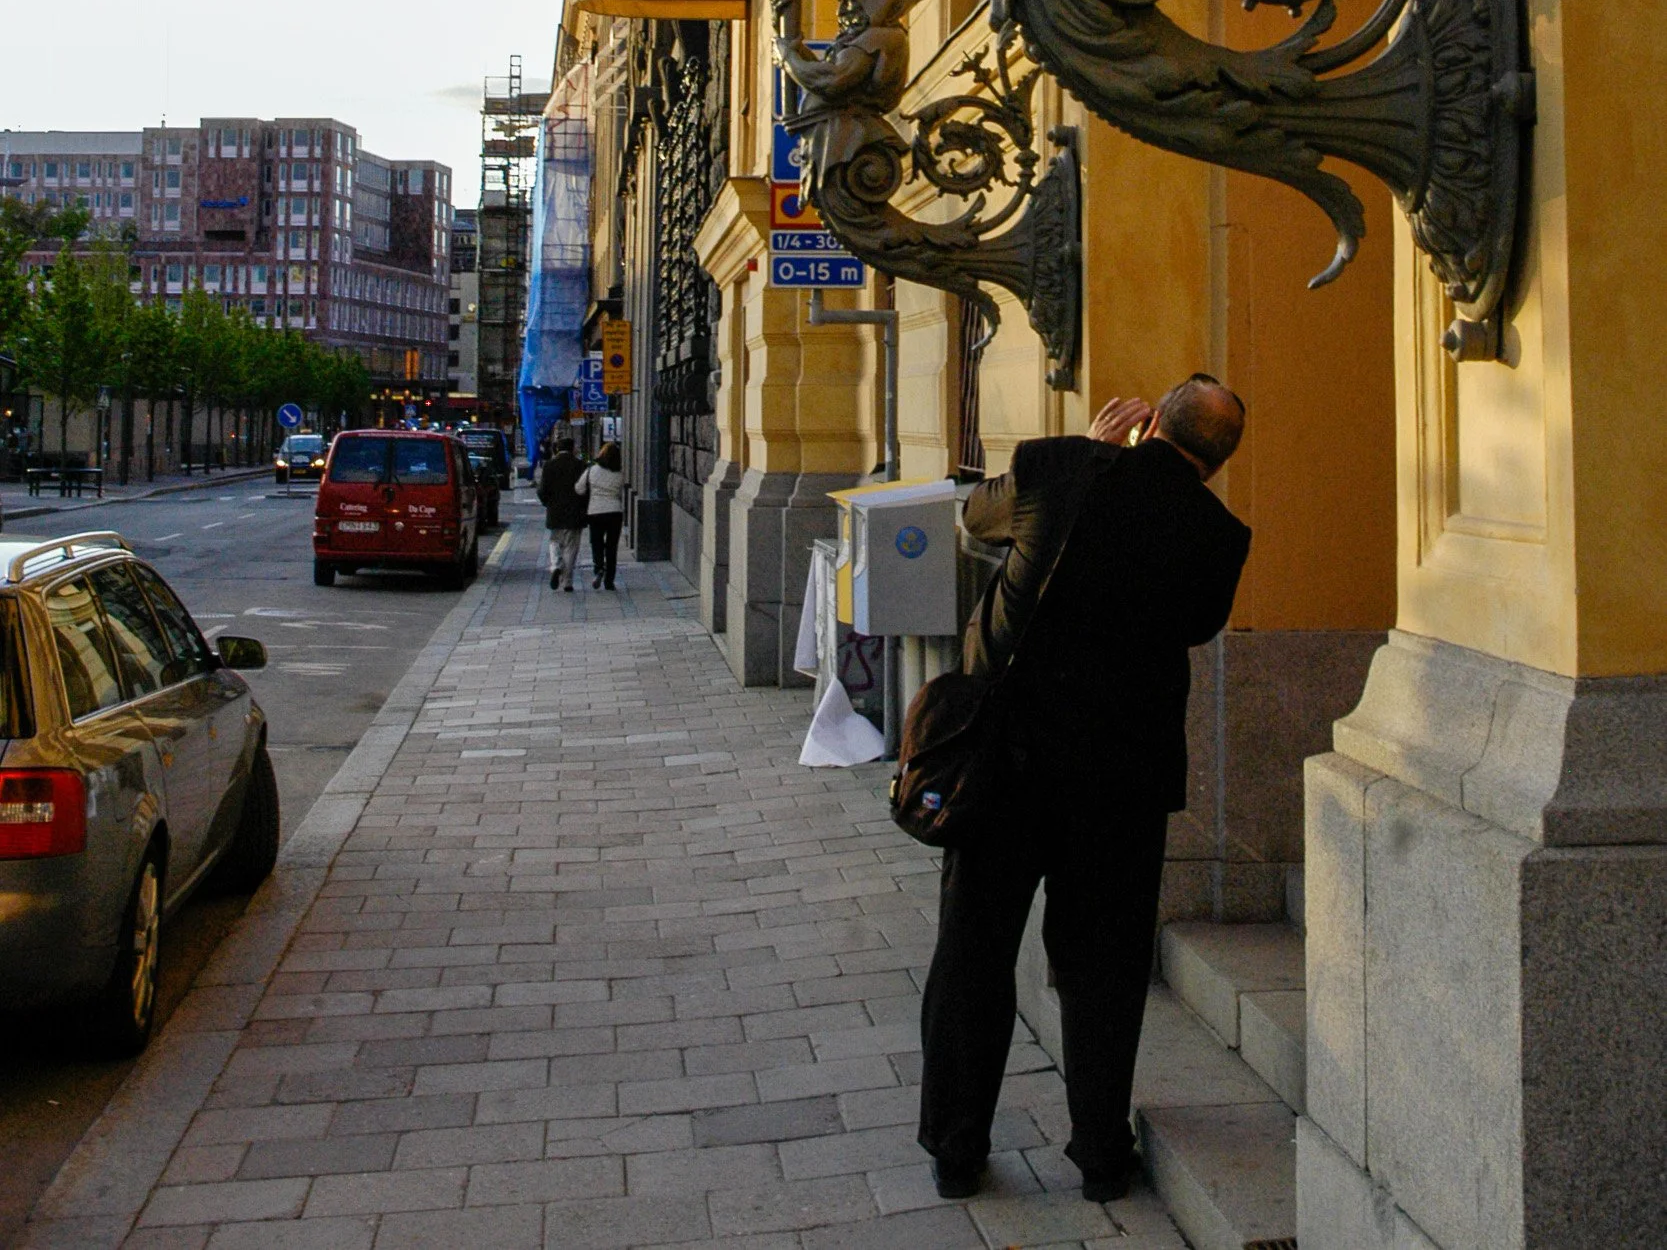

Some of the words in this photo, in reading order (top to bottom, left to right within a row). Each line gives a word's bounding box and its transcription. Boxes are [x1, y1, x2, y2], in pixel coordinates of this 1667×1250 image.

[777, 234, 801, 250] 1/4
[778, 262, 830, 281] 0-15
[840, 266, 859, 281] m
[590, 361, 602, 378] P
